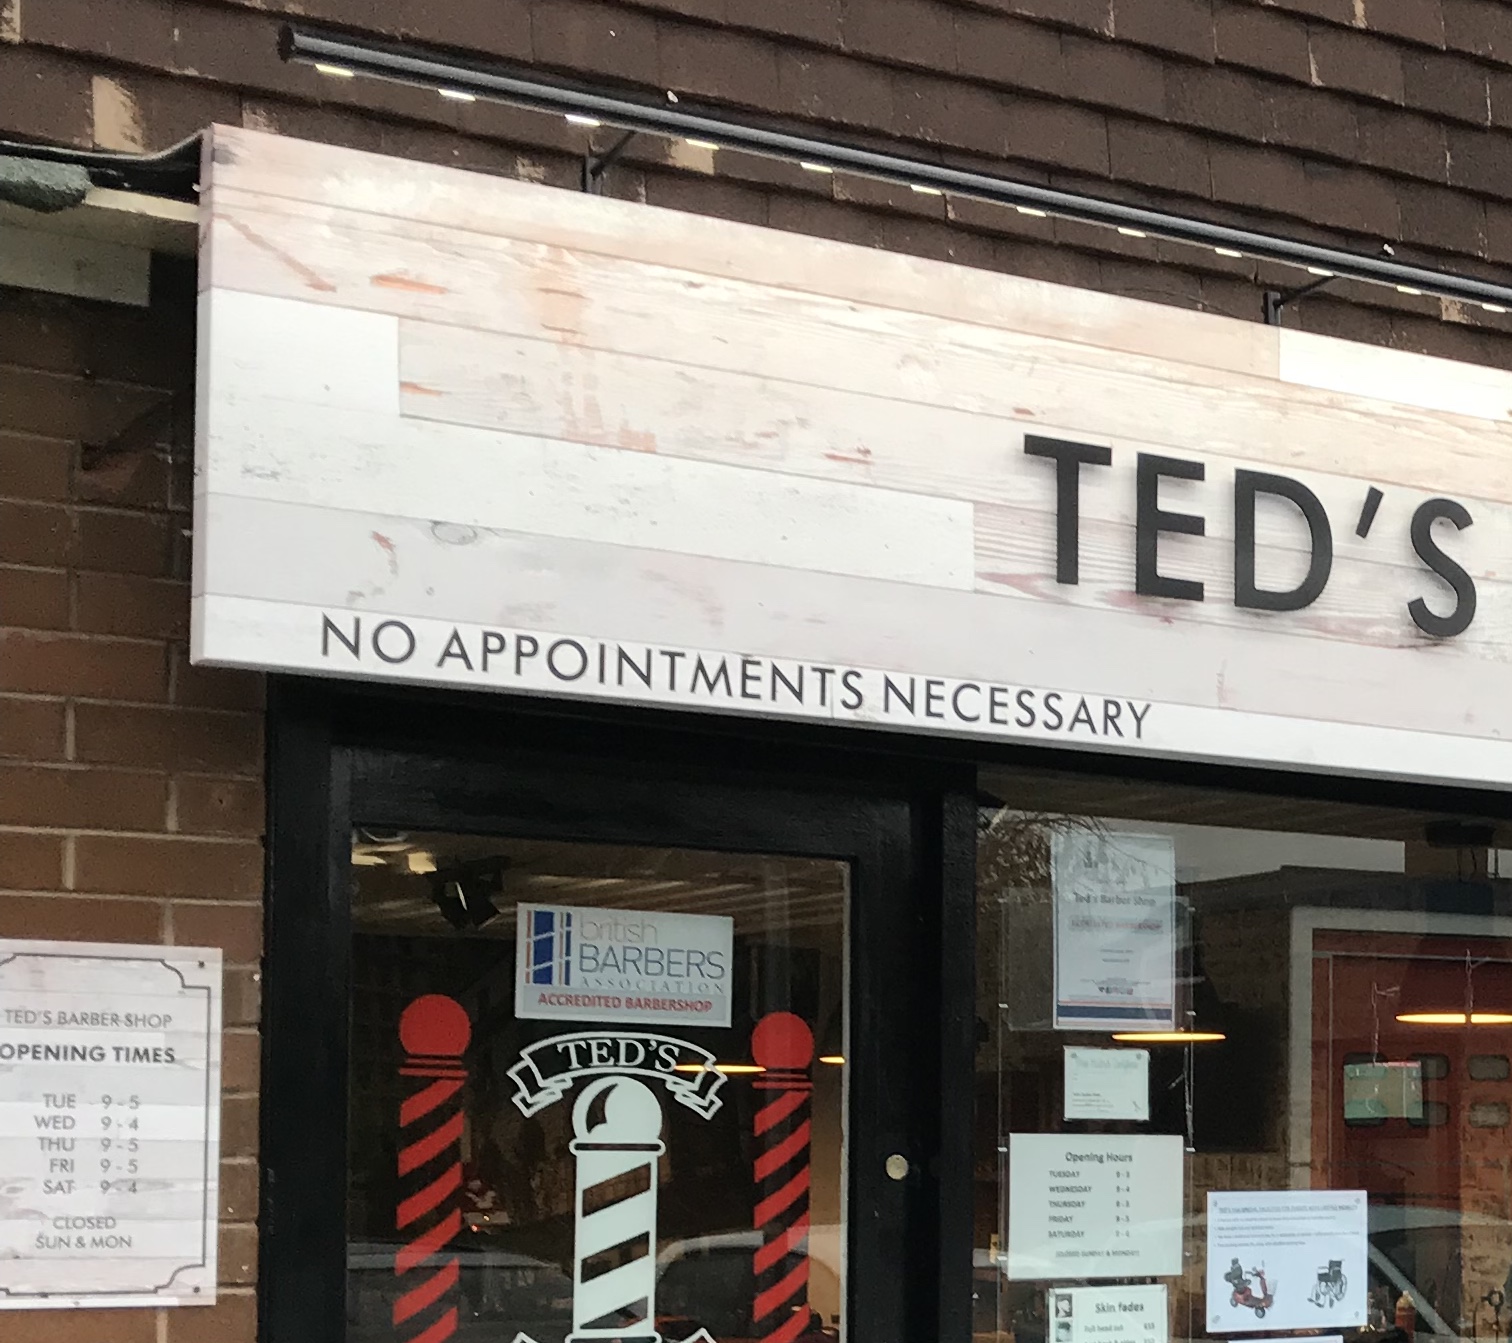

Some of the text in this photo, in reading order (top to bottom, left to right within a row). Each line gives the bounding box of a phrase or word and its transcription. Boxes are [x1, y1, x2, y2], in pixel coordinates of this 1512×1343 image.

[1024, 434, 1476, 638] TED'S
[322, 612, 1151, 739] NO APPOINTMENTS NECESSARY
[580, 943, 725, 980] BARBERS
[538, 993, 713, 1013] ACCREDITED BARBERSHOP
[5, 1008, 173, 1029] TED'S BARBER SHOP
[0, 1043, 176, 1064] OPENING TIMES
[557, 1038, 680, 1072] TED'S
[43, 1093, 76, 1109] TUE
[101, 1095, 112, 1109] 9
[127, 1095, 139, 1109] 5
[34, 1114, 76, 1130] WED
[101, 1116, 112, 1130] 9
[128, 1116, 139, 1130] 4
[38, 1137, 75, 1152] THU
[101, 1137, 112, 1152] 9
[127, 1137, 139, 1152] 5
[49, 1158, 75, 1173] FRI
[100, 1158, 111, 1173] 9
[127, 1158, 139, 1173] 5
[1065, 1152, 1133, 1163] Opening Hours
[43, 1179, 75, 1194] SAT
[100, 1180, 111, 1194] 9
[128, 1180, 139, 1194] 4
[52, 1216, 117, 1230] CLOSED
[35, 1234, 132, 1249] SUN & MON
[1095, 1302, 1116, 1314] Skin
